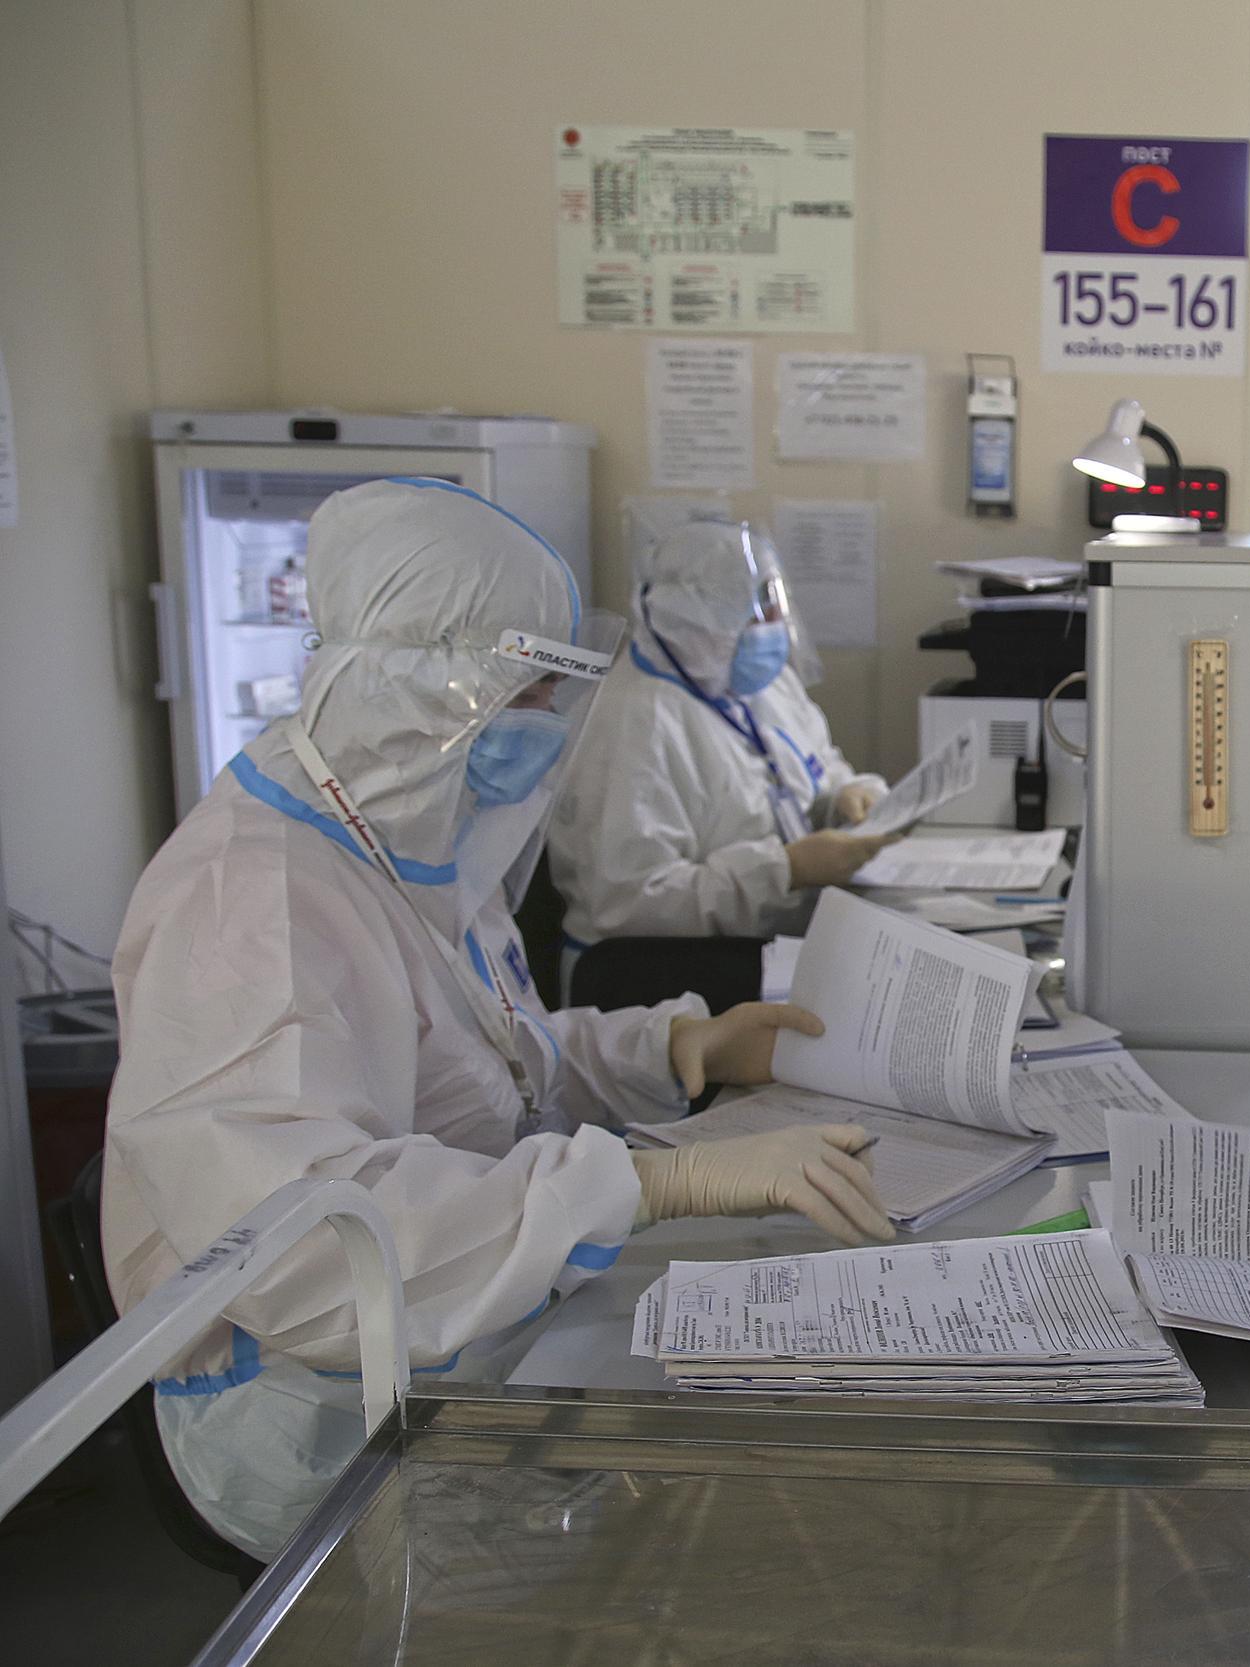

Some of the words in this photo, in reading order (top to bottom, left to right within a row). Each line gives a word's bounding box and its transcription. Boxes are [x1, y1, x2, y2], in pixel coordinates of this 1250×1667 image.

[1121, 146, 1173, 163] пост
[1053, 271, 1237, 330] 155-161
[1064, 337, 1196, 359] койко-места
